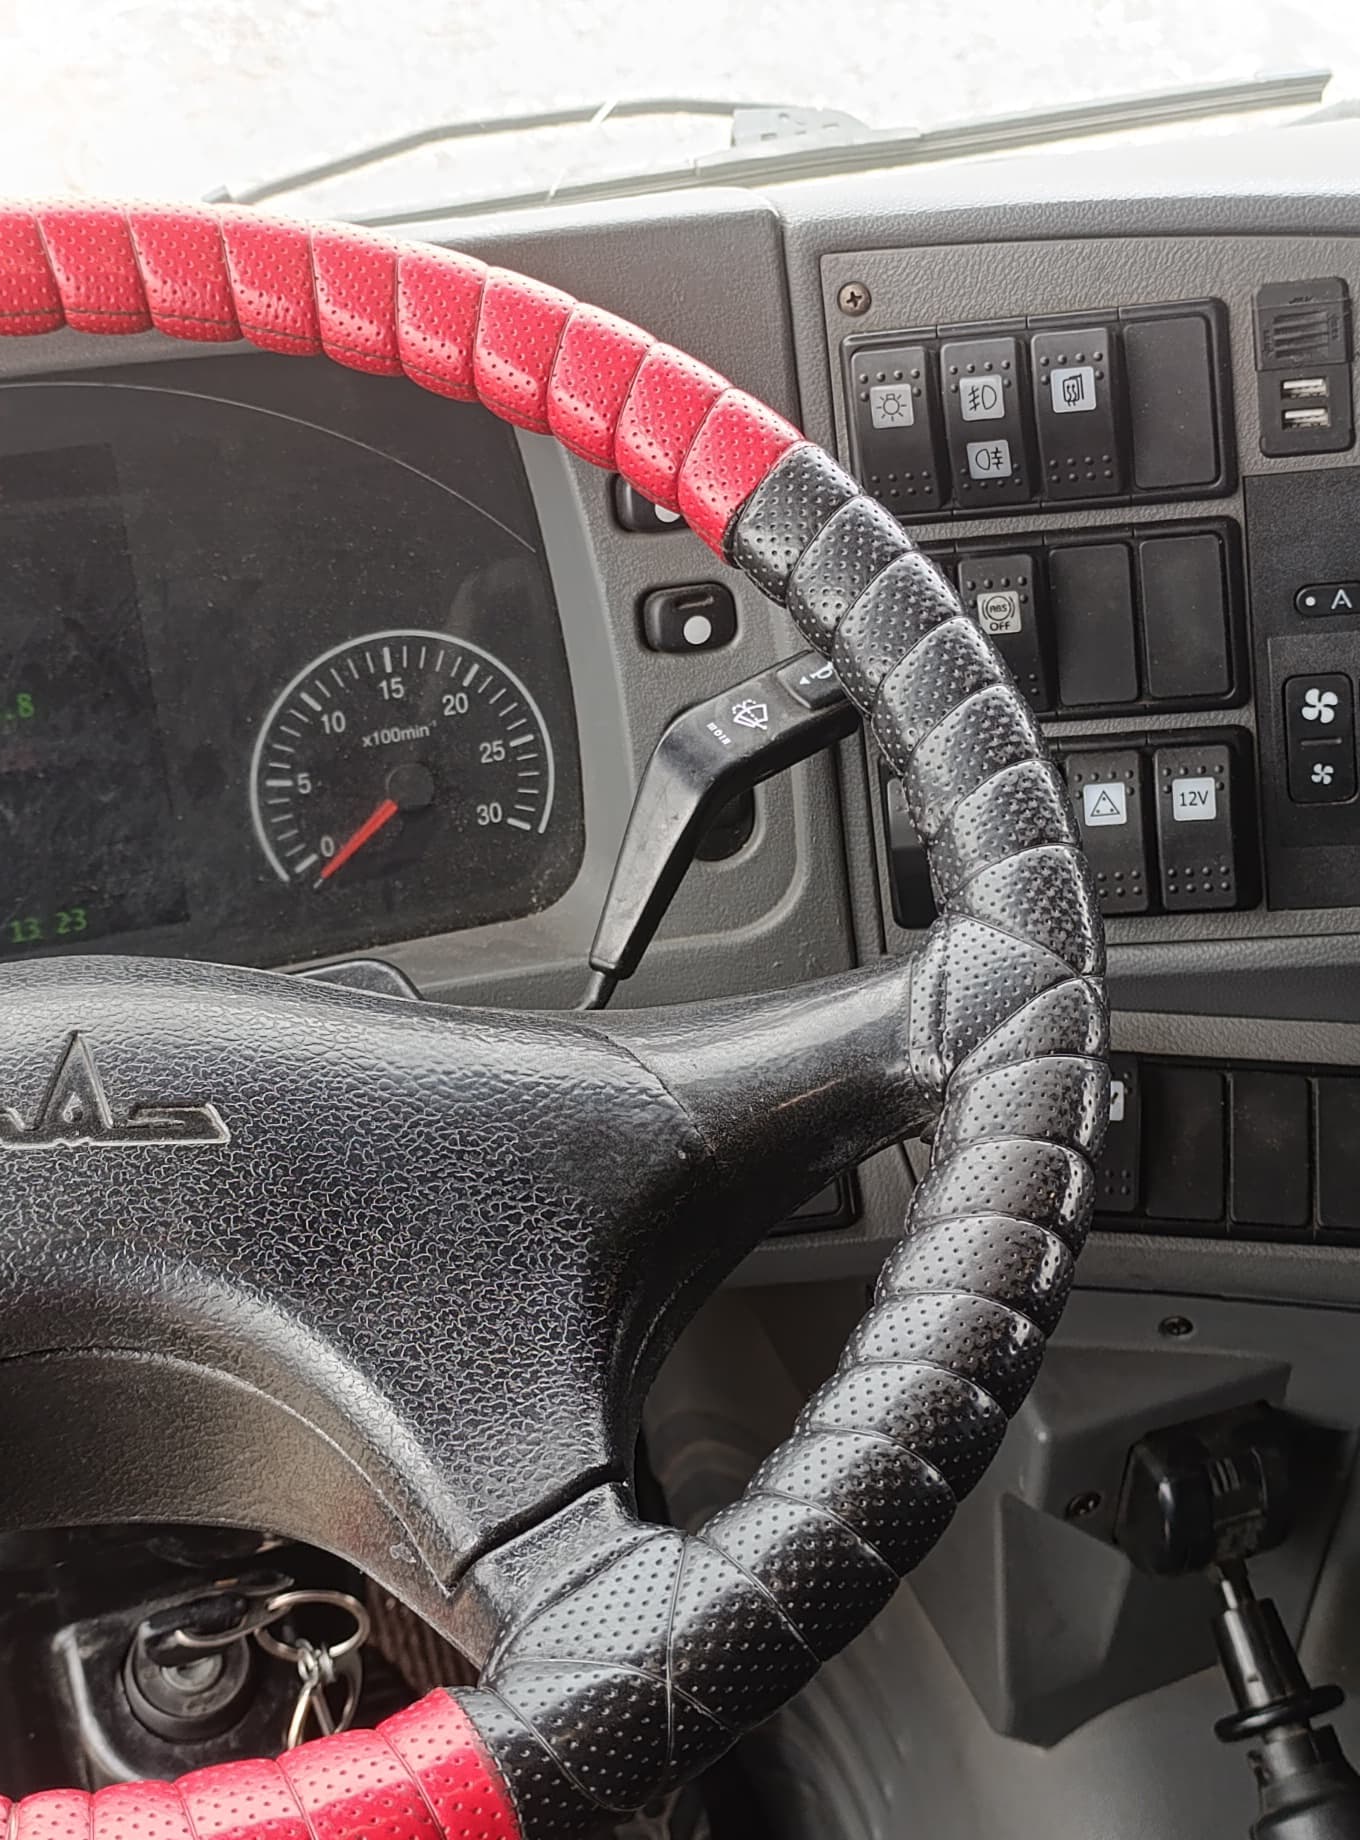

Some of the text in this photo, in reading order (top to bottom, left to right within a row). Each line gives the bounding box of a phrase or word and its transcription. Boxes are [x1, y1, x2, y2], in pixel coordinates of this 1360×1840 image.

[1331, 588, 1352, 610] A
[989, 621, 1010, 631] OFF
[379, 677, 405, 700] 15
[442, 692, 469, 716] 20
[320, 711, 346, 734] 10
[479, 740, 506, 764] 25
[297, 773, 312, 794] 5
[1180, 790, 1209, 807] 12V
[476, 802, 503, 825] 30
[320, 836, 335, 857] 0
